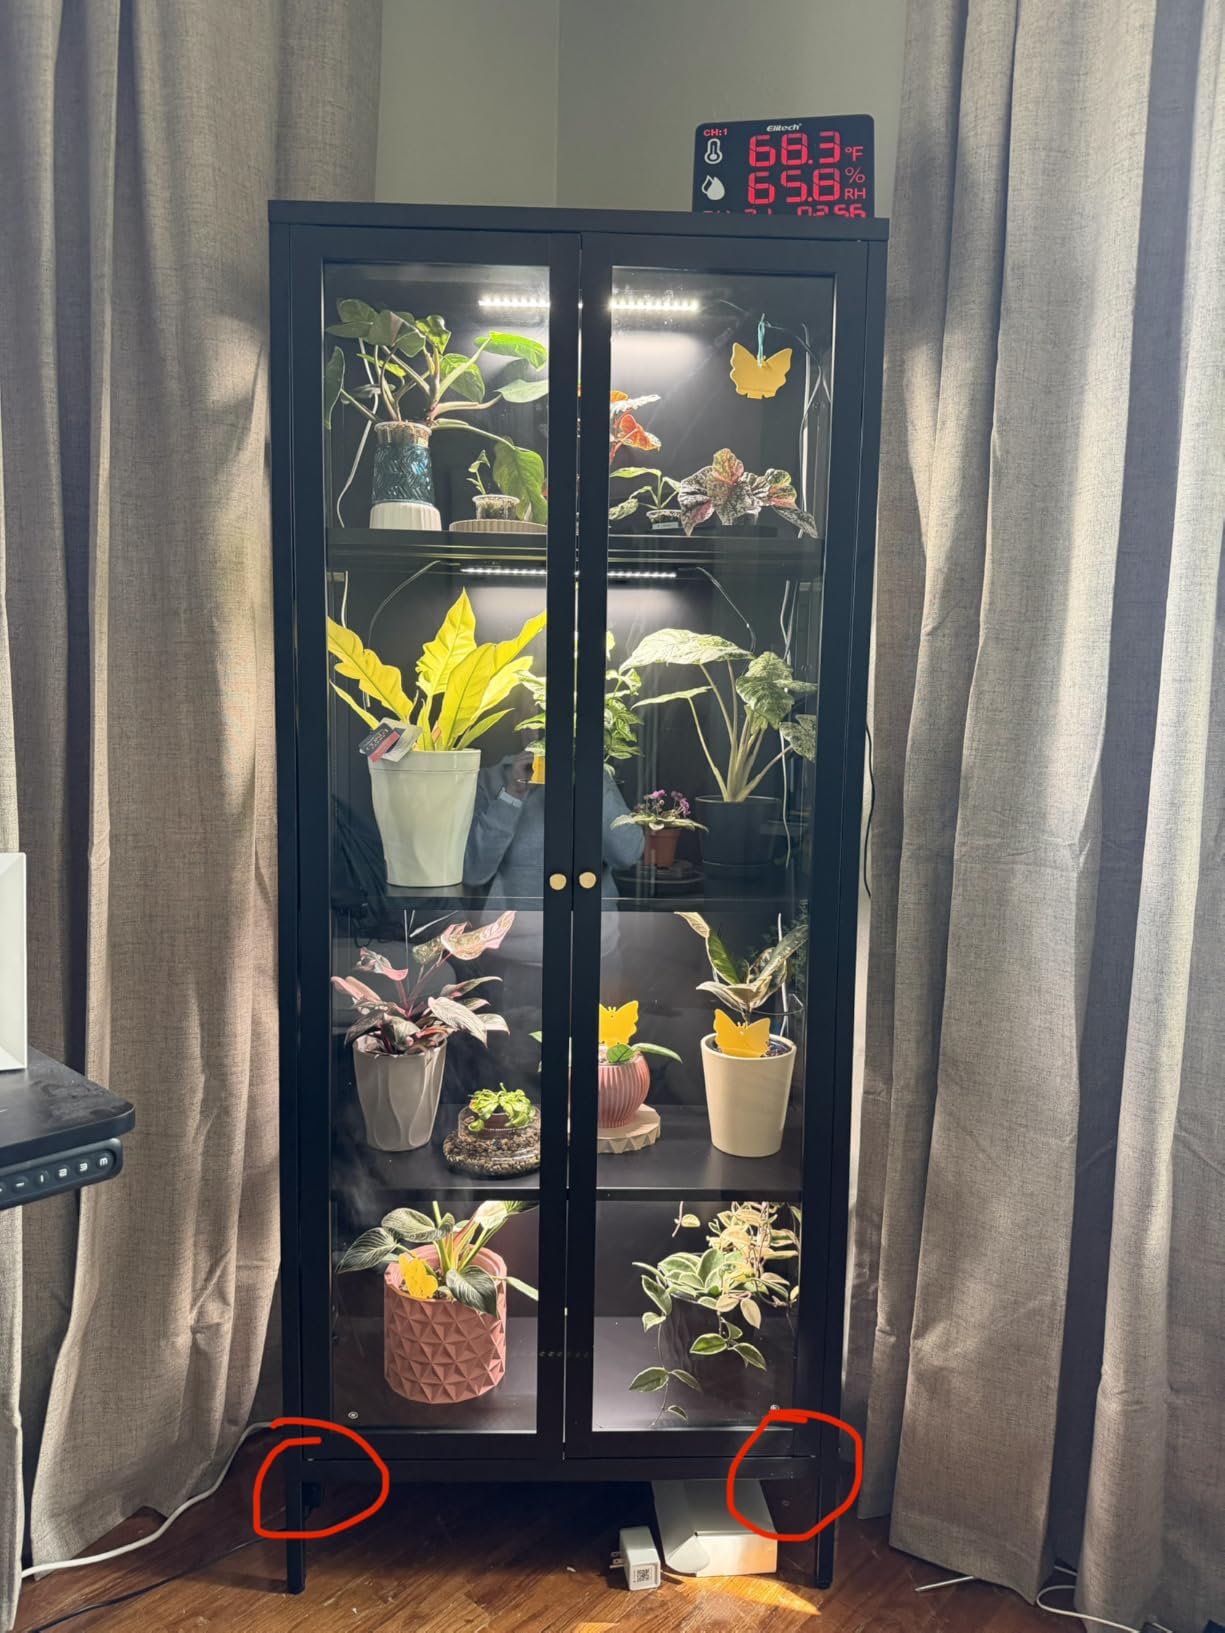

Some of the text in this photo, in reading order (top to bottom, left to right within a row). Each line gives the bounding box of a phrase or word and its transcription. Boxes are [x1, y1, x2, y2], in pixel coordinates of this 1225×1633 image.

[703, 128, 728, 137] CH:1
[766, 123, 801, 132] Elitech
[749, 131, 841, 167] 68.3
[748, 168, 841, 205] 65.8
[844, 188, 866, 200] RH
